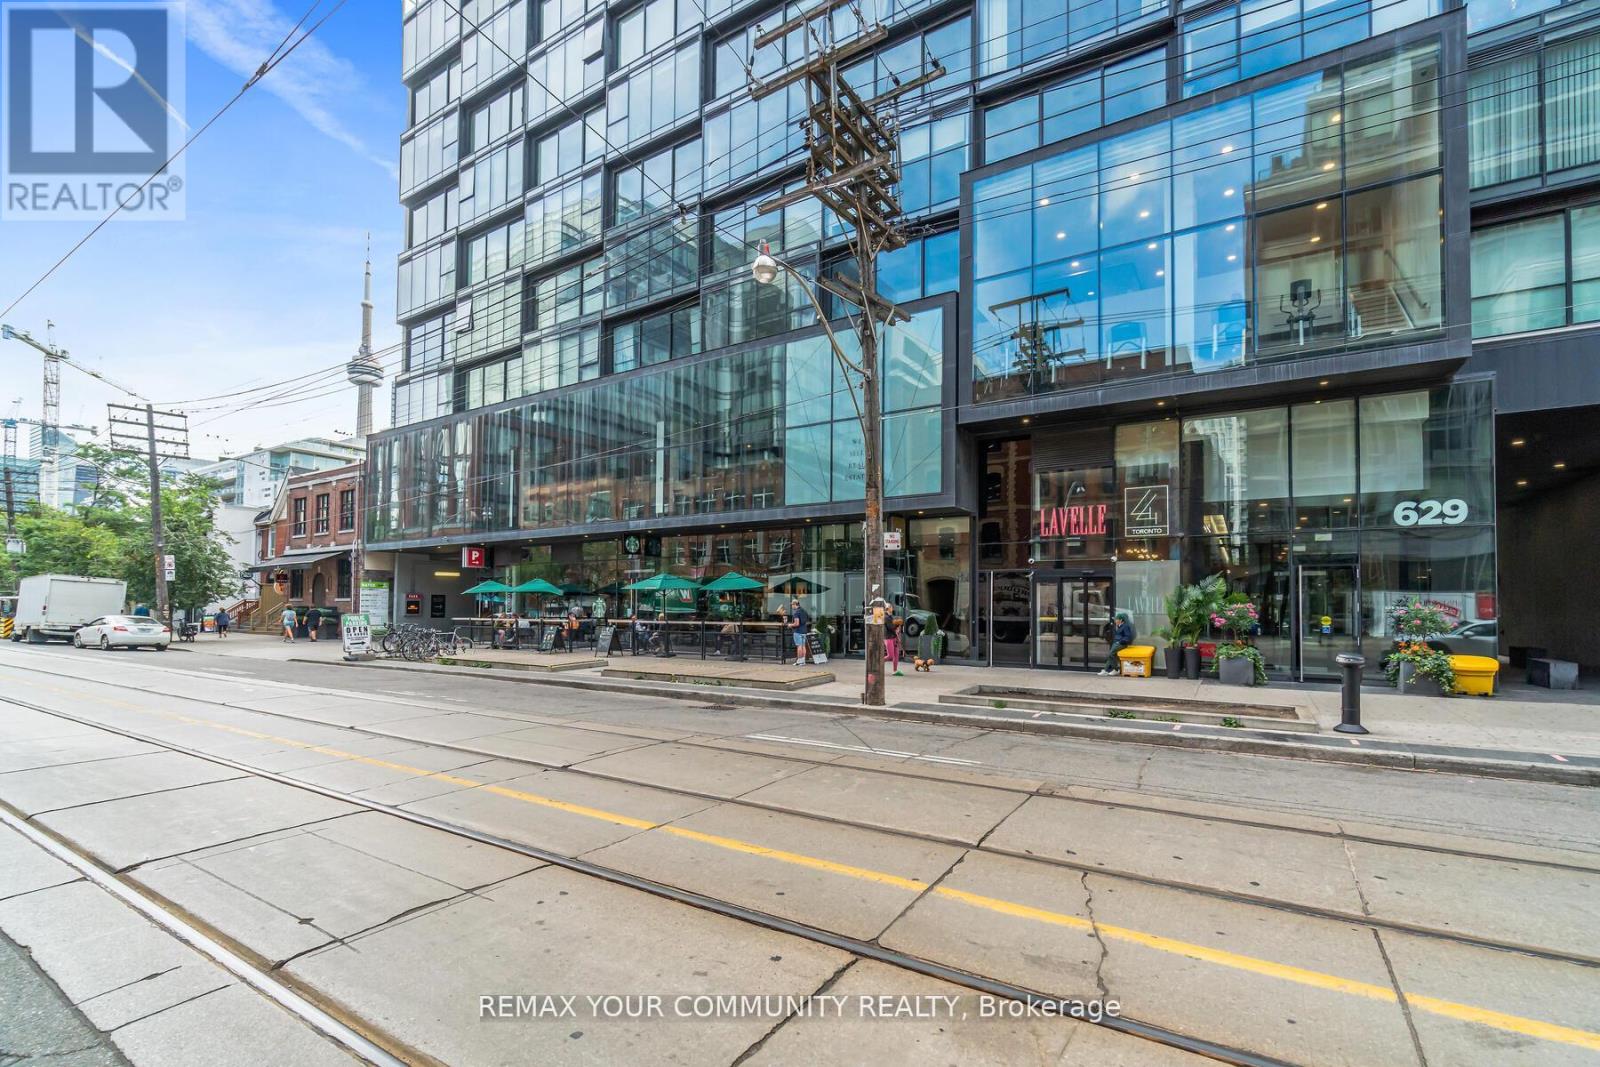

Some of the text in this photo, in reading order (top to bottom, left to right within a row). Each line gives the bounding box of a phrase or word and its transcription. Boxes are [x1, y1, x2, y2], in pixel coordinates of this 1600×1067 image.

[1040, 504, 1107, 537] LAVELLE
[1393, 498, 1469, 526] 629
[472, 550, 480, 561] P
